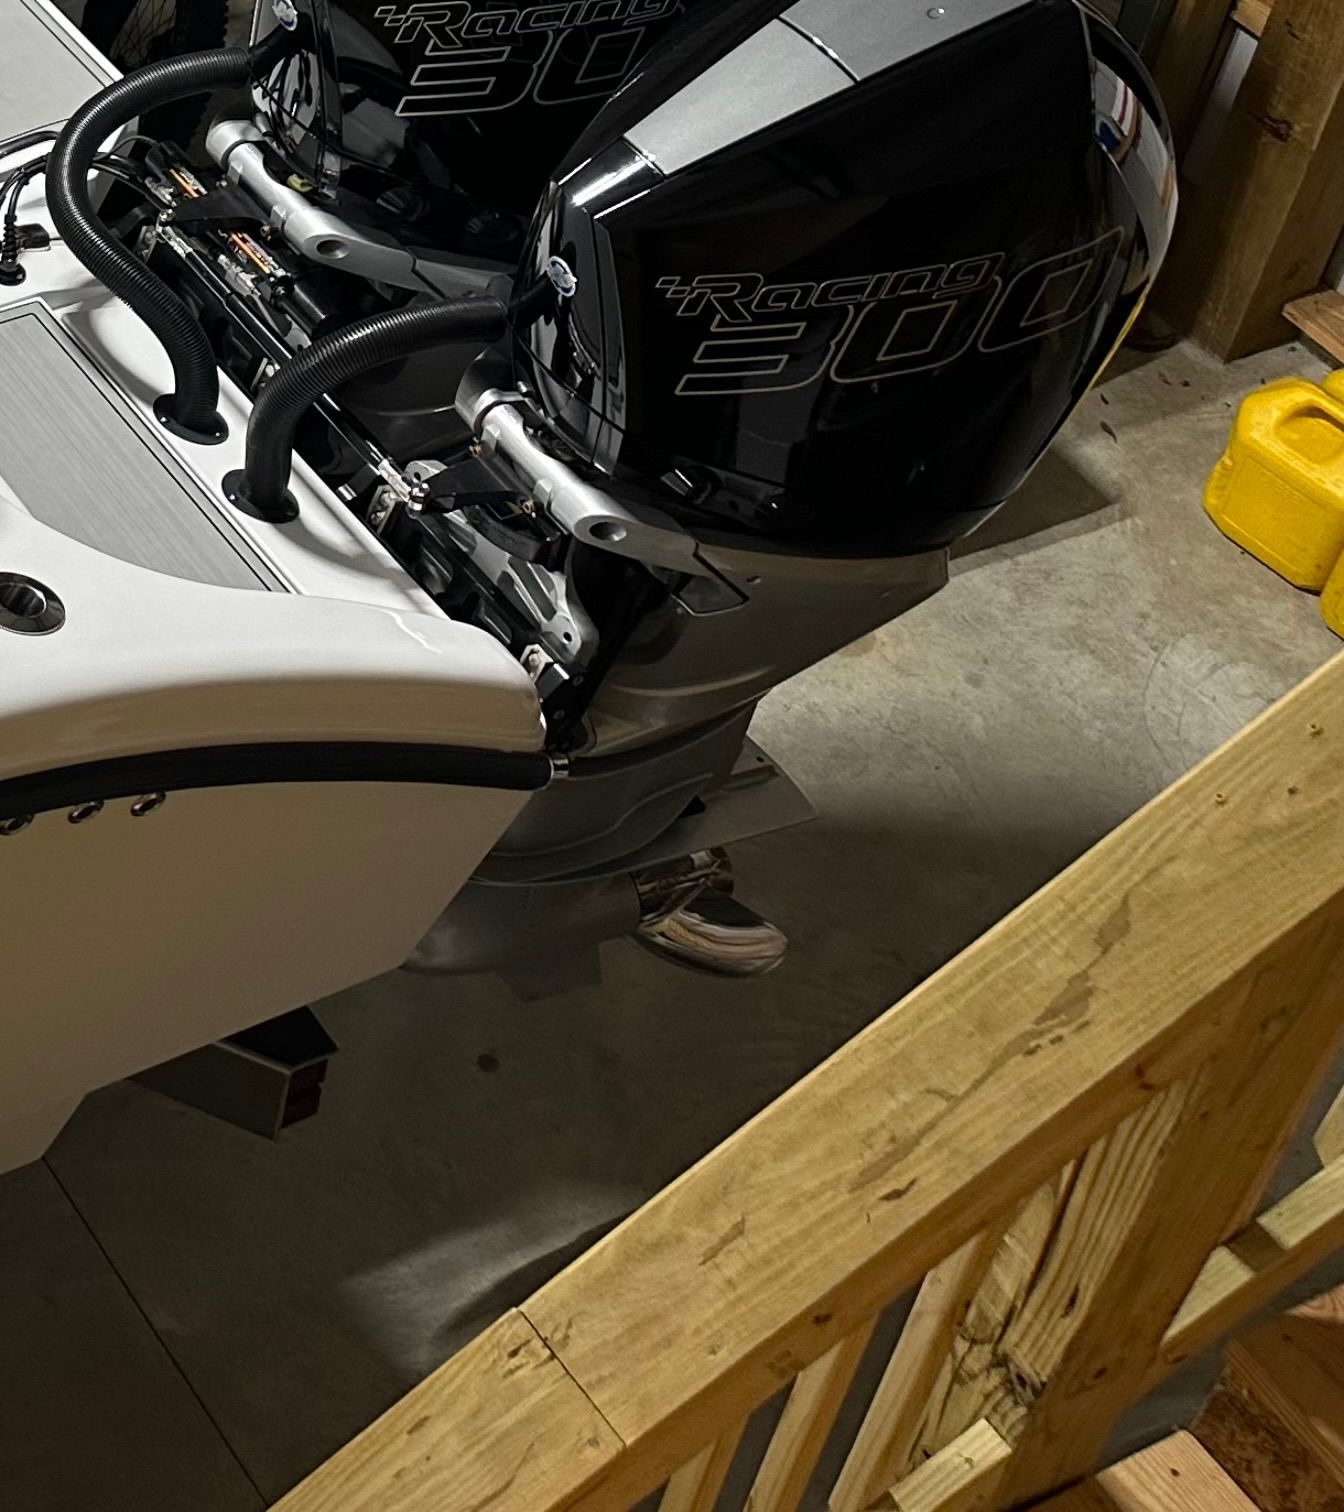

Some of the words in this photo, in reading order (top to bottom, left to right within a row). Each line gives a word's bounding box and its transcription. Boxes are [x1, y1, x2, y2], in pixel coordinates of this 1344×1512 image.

[395, 1, 686, 118] 30
[655, 252, 1005, 323] Racing
[675, 226, 1124, 396] 300
